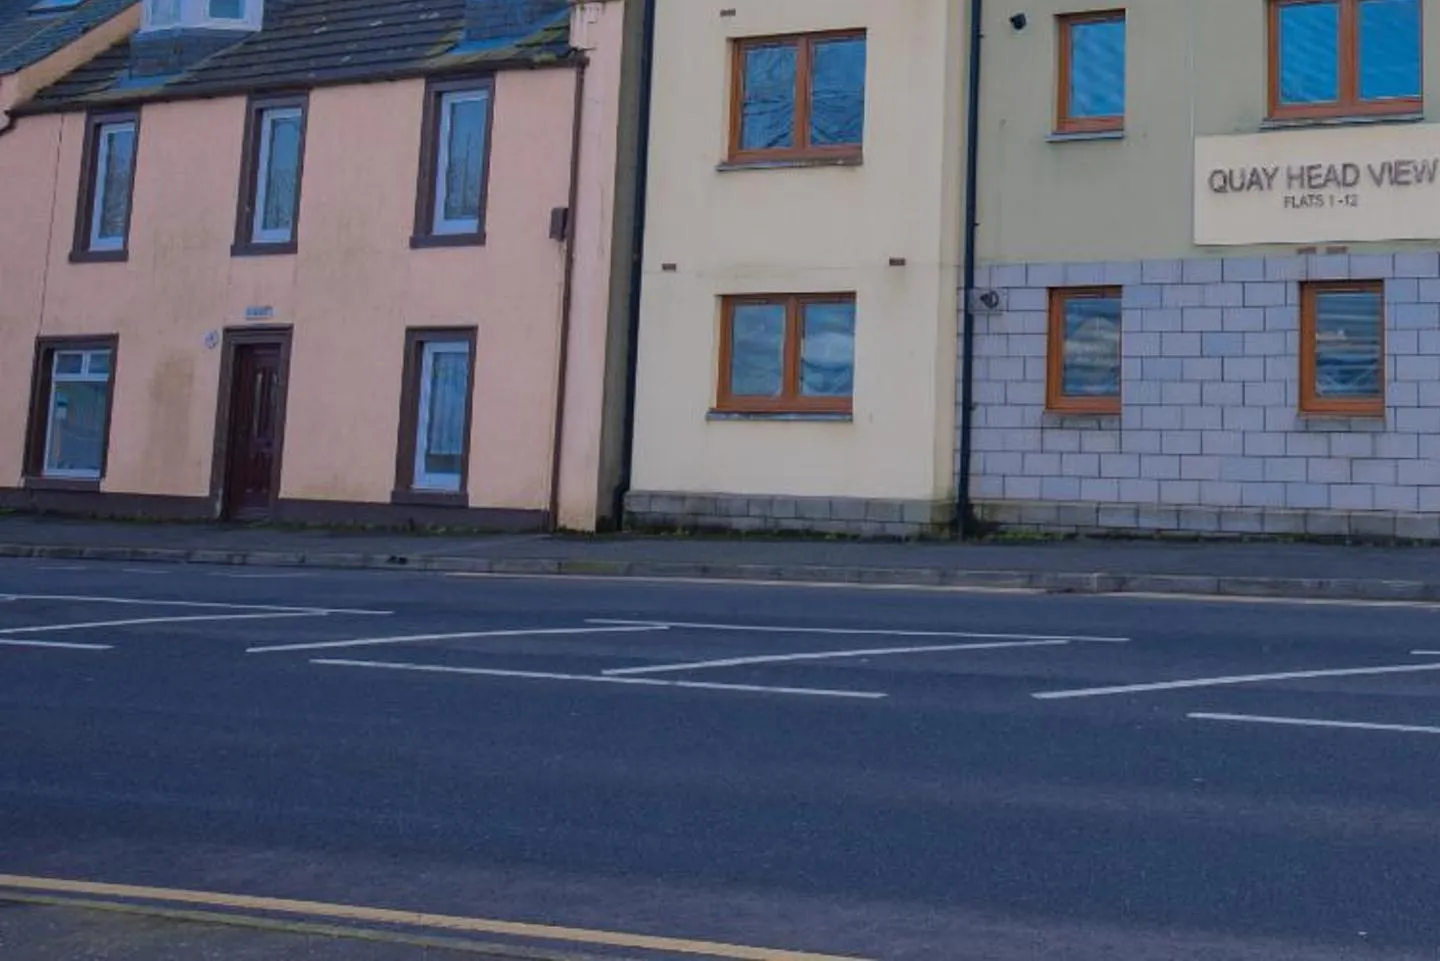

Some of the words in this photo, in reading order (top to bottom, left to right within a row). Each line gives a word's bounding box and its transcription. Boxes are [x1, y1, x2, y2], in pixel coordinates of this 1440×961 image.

[1208, 167, 1278, 193] QUAY
[1286, 163, 1360, 189] HEAD
[1367, 159, 1439, 187] VIEW
[1284, 194, 1324, 208] FLATS
